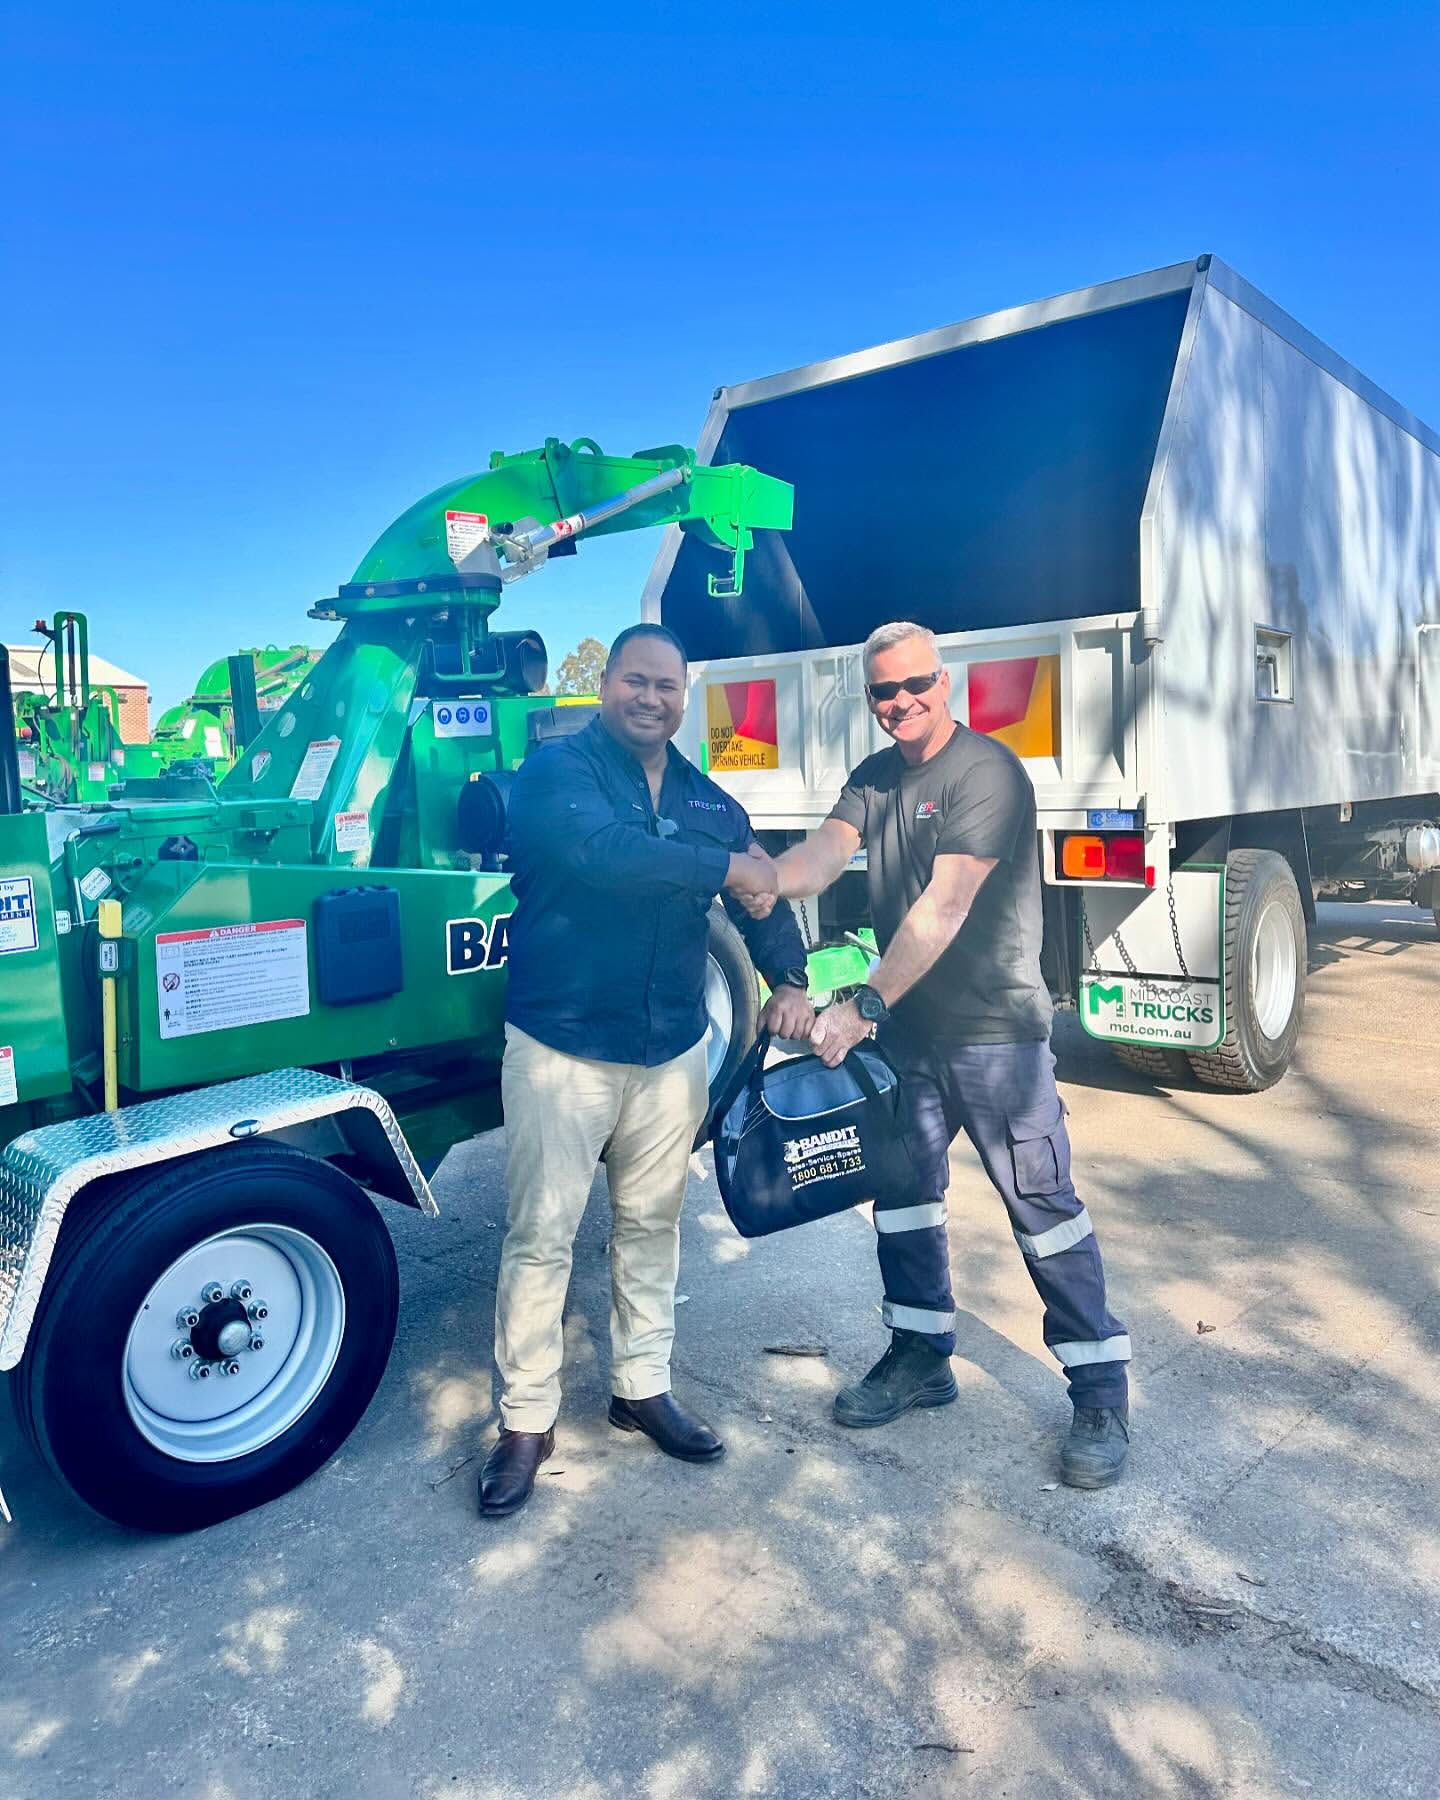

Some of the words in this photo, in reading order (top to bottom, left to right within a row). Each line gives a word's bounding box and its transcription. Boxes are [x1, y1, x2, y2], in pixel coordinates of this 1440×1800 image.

[711, 727, 720, 740] DO
[721, 726, 733, 739] NOT
[712, 740, 744, 754] OVERTAKE
[740, 753, 766, 767] VEHICLE
[220, 925, 257, 936] DANGER
[1130, 988, 1213, 1006] MIDCOAST
[1131, 1001, 1214, 1024] TRUCKS
[799, 1125, 857, 1151] BANDIT
[792, 1166, 817, 1183] 1800
[819, 1160, 839, 1175] 681
[841, 1155, 862, 1169] 733
